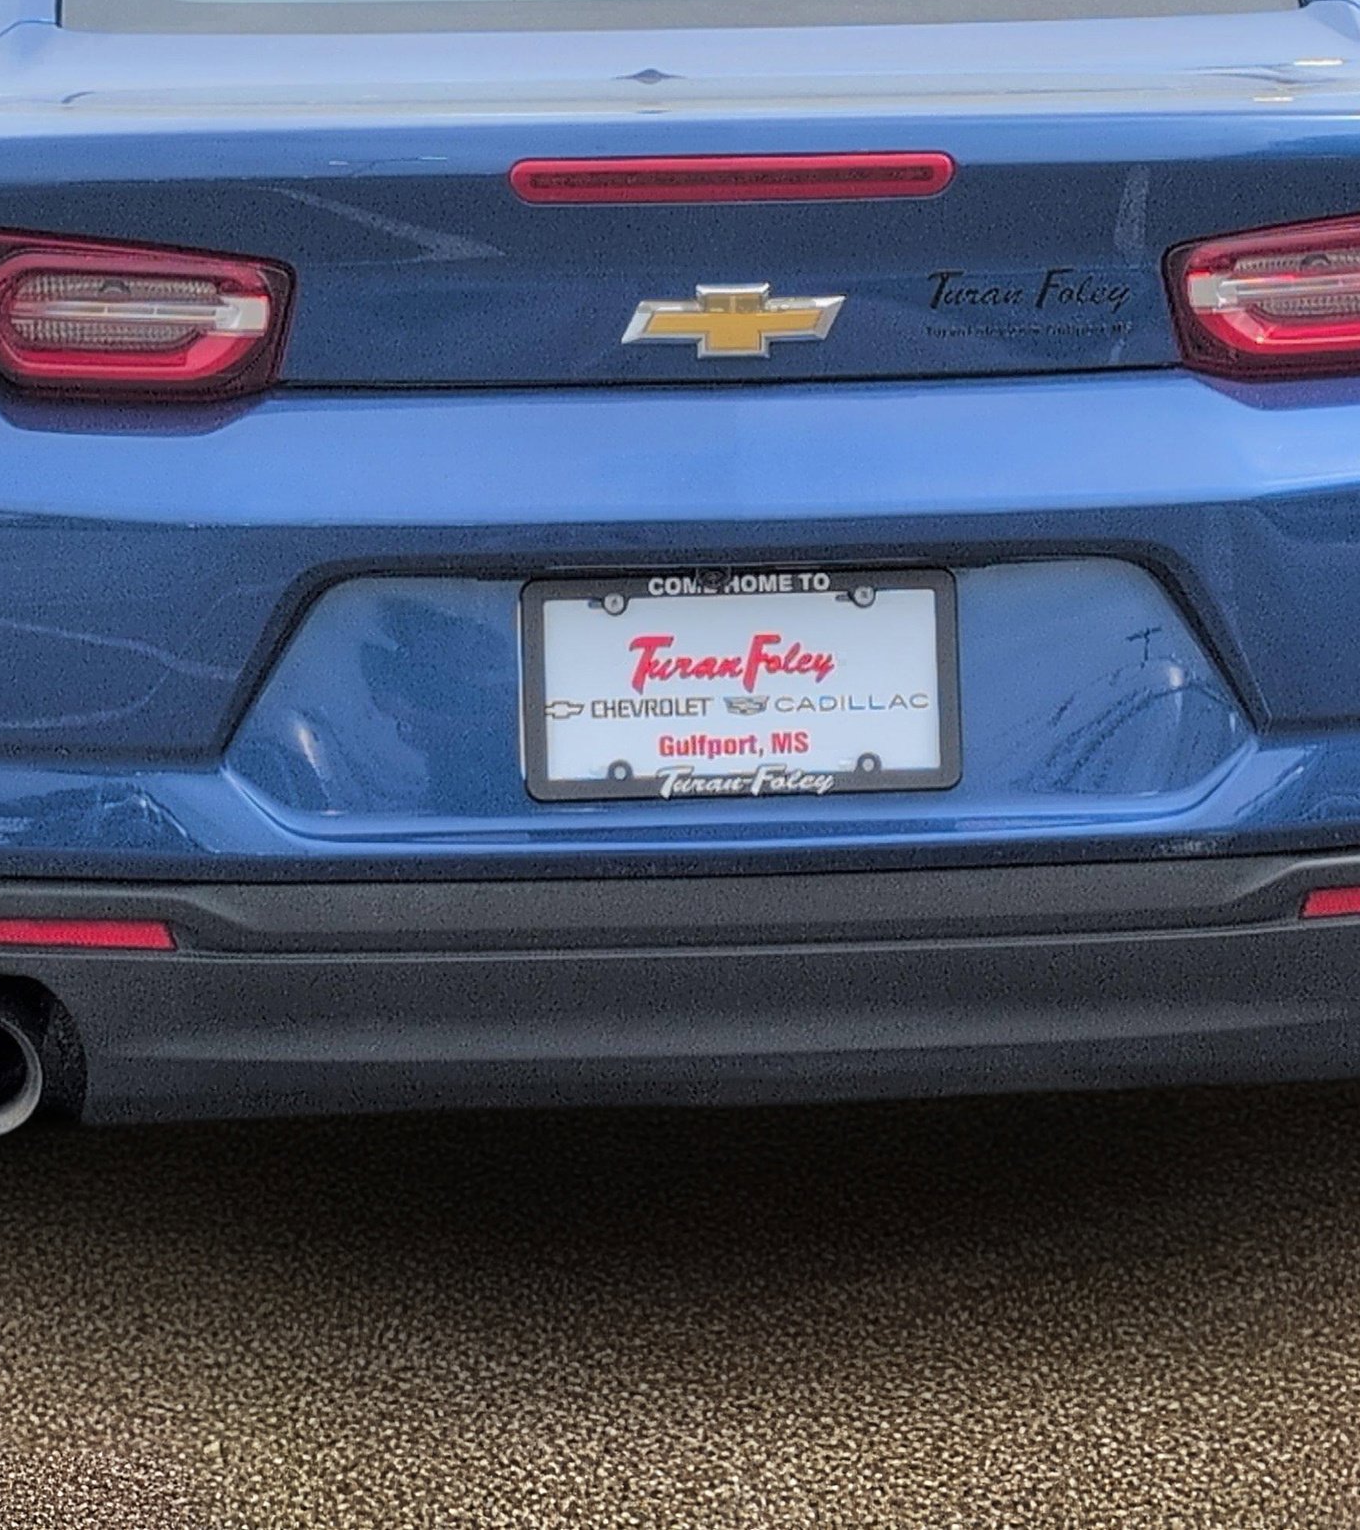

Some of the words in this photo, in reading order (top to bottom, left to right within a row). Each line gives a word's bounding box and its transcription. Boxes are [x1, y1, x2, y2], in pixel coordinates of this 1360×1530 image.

[928, 269, 1024, 310] Turan
[1034, 268, 1131, 314] Foley
[798, 572, 830, 591] TO
[591, 697, 714, 719] CHEVROLET
[774, 693, 930, 713] CADILLAC
[658, 734, 765, 760] Gulfport,
[771, 731, 810, 755] MS
[750, 763, 836, 798] Foley
